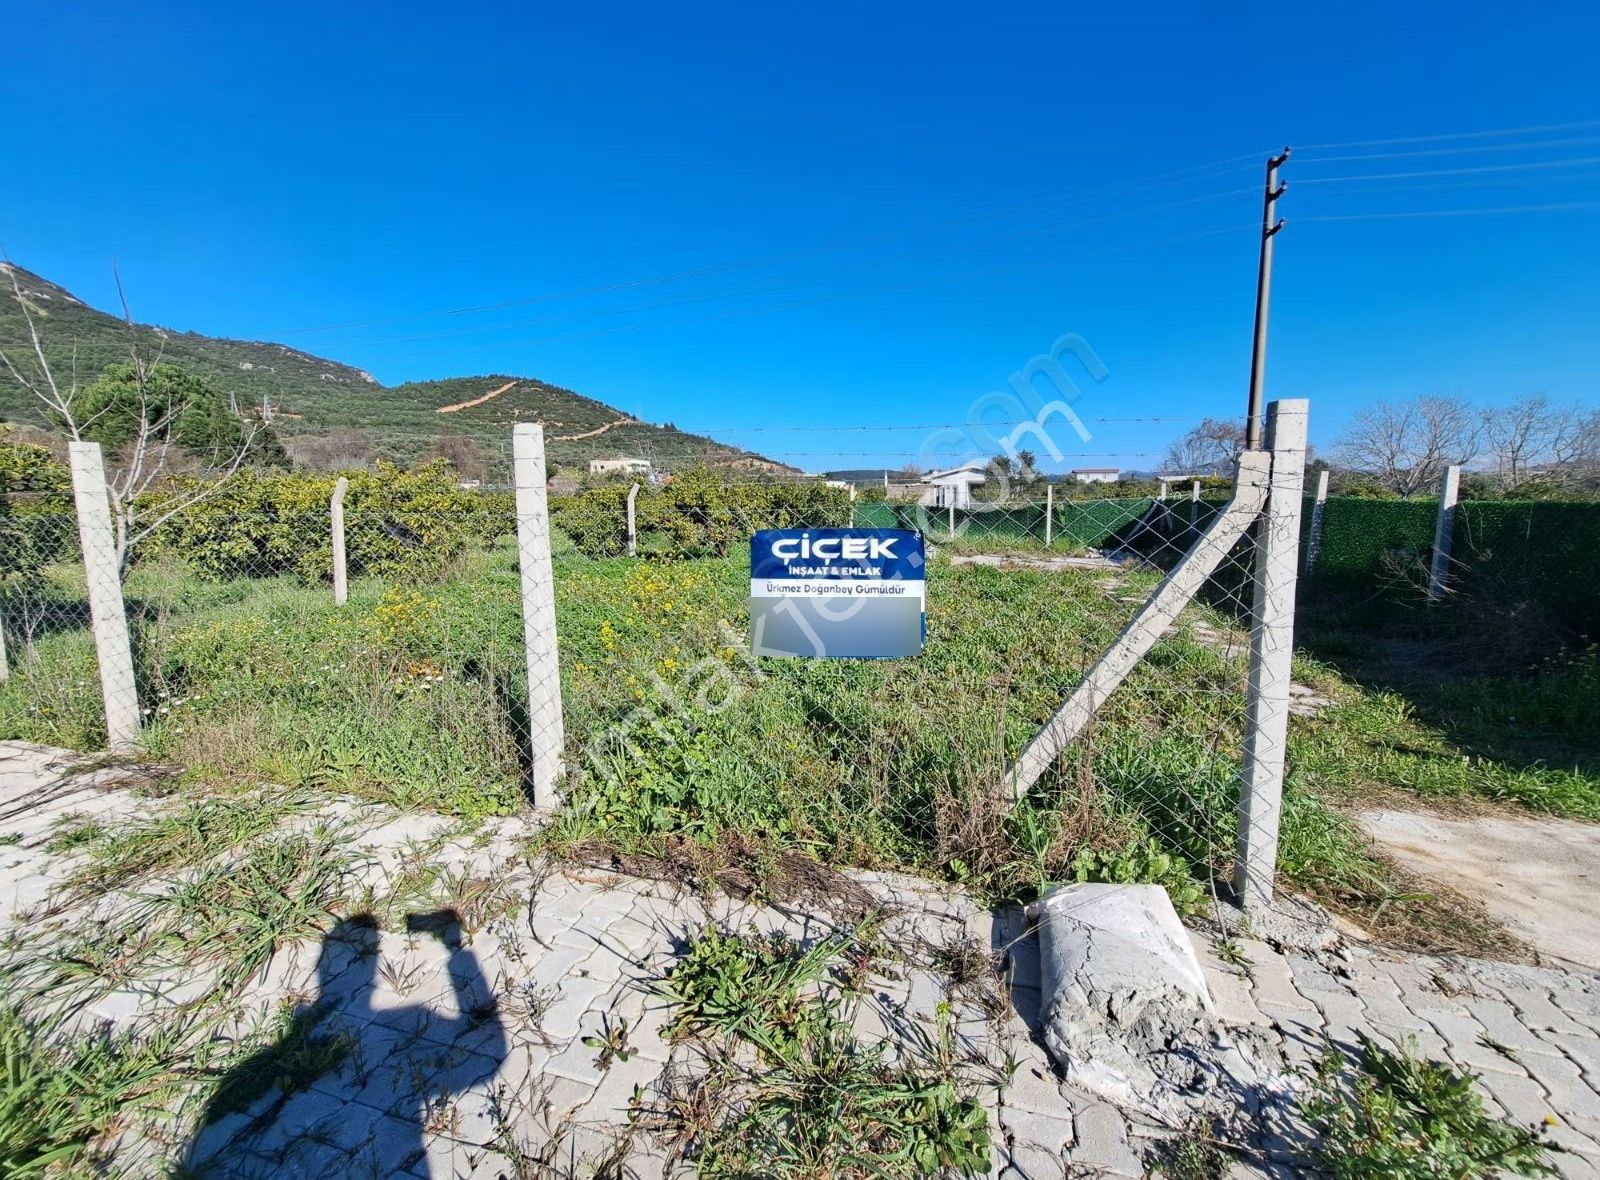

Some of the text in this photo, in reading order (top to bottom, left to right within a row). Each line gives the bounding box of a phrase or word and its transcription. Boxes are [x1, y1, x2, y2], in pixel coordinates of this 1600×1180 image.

[771, 533, 900, 566] ÇİÇEK
[788, 564, 881, 578] İNŞAAT & EMLAK
[766, 581, 906, 596] Ürkmez Doğanbey Gümüldür
